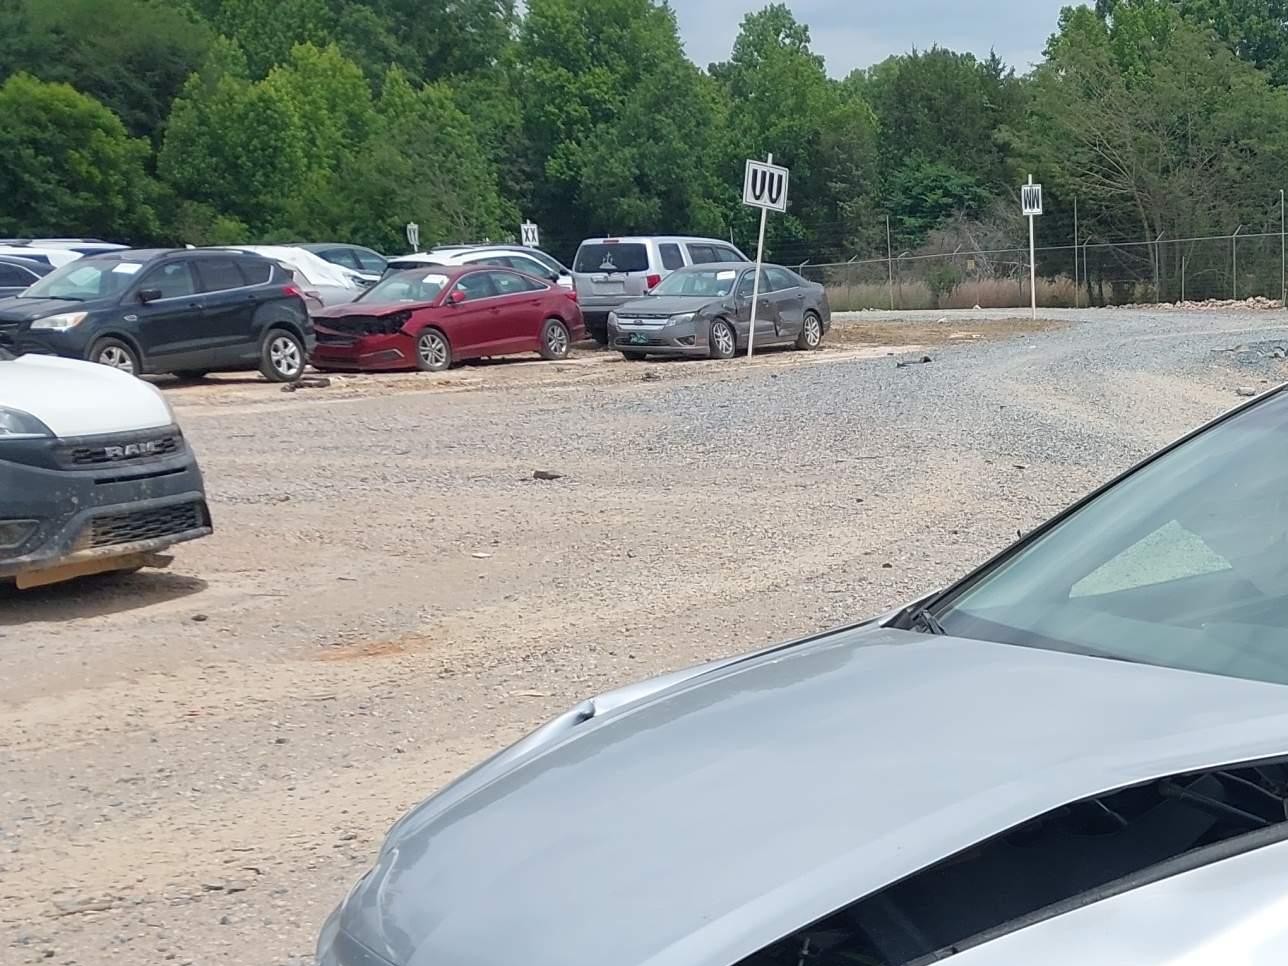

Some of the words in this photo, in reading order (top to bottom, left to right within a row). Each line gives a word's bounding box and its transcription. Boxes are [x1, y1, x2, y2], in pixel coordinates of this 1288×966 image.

[1023, 188, 1040, 210] WW
[523, 227, 537, 242] XX
[104, 441, 158, 457] RAM
